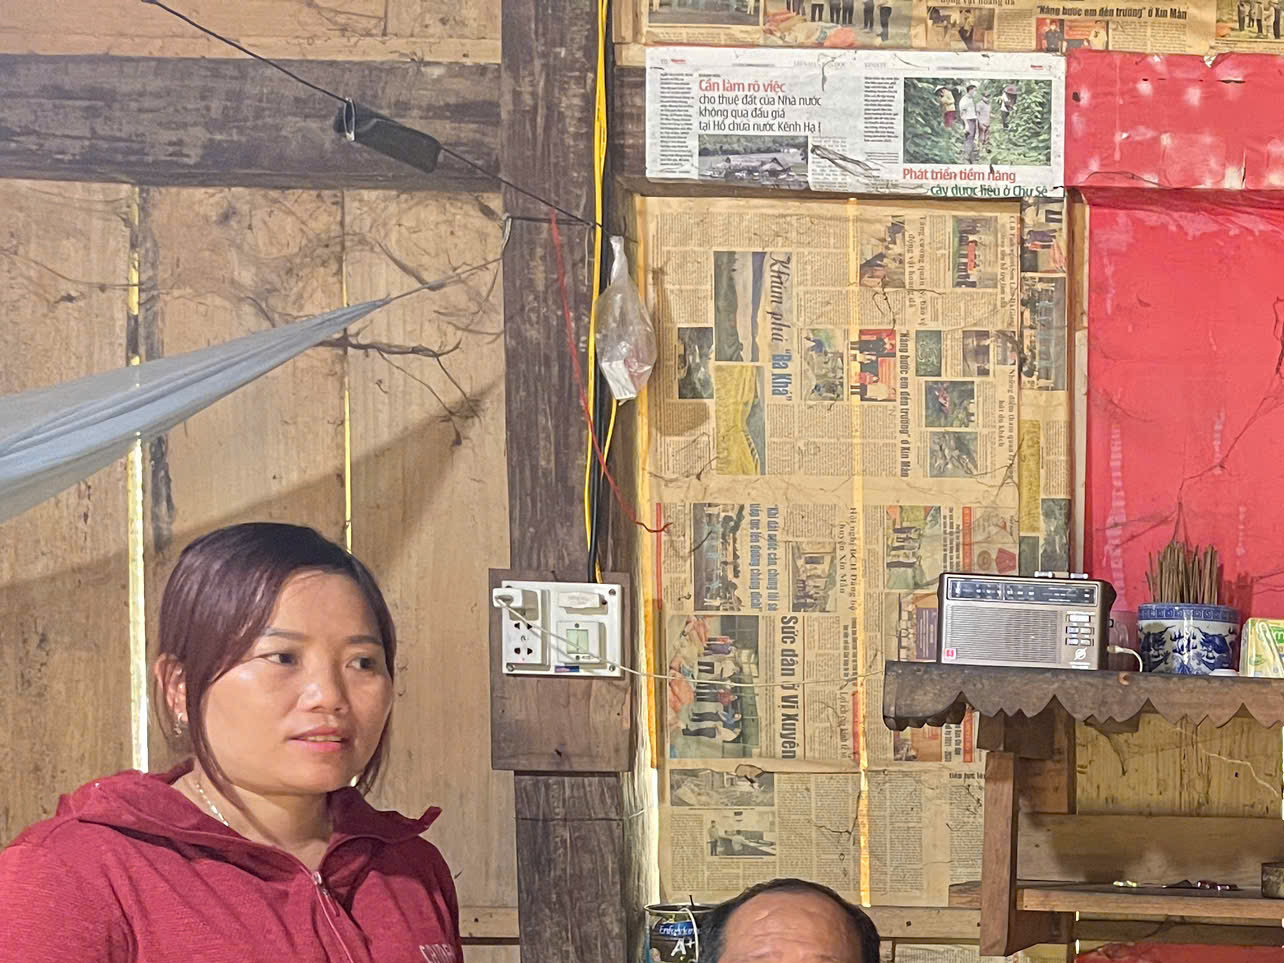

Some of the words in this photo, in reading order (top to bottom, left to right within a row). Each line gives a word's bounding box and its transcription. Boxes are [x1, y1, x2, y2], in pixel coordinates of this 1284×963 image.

[699, 79, 719, 93] Cần
[723, 79, 744, 92] làm
[750, 80, 760, 92] rõ
[763, 79, 785, 93] việc
[699, 94, 716, 105] cho
[742, 93, 757, 105] đất
[759, 94, 775, 105] của
[778, 94, 796, 106] Nhà
[800, 95, 821, 106] nước
[699, 106, 729, 121] không
[731, 108, 748, 121] qua
[751, 106, 769, 118] đấu
[771, 107, 785, 121] giá
[903, 168, 928, 180] Phát
[931, 168, 957, 181] triển
[960, 168, 984, 181] tiềm
[780, 616, 799, 644] Sức
[781, 648, 799, 676] dân
[778, 695, 799, 708] Vị
[780, 713, 799, 758] Xuyên
[671, 937, 695, 956] A+
